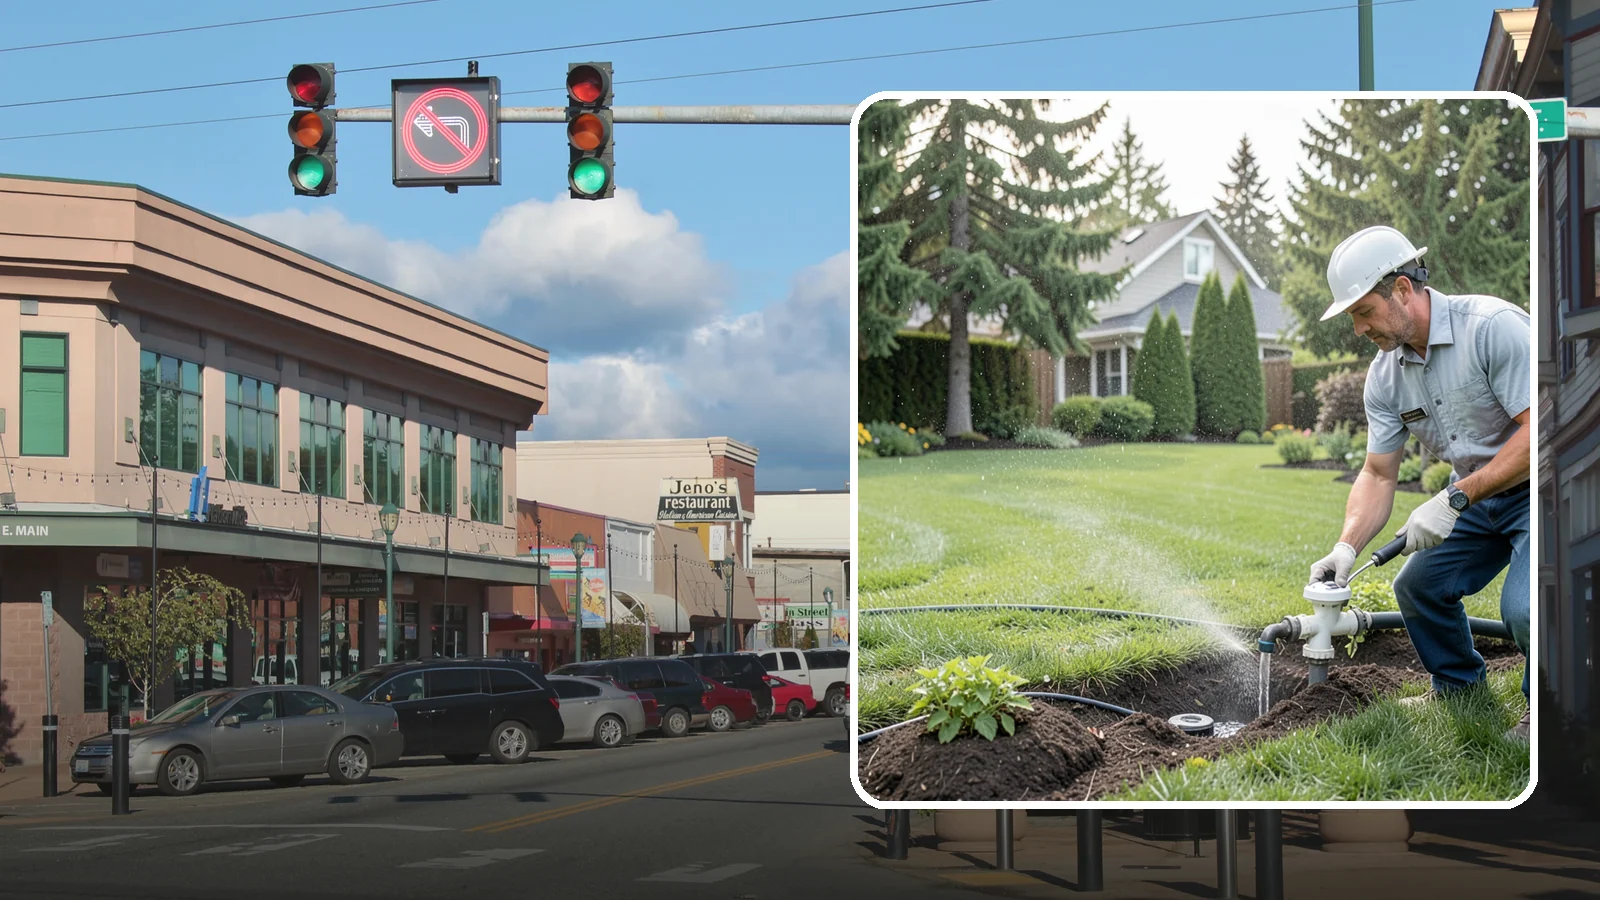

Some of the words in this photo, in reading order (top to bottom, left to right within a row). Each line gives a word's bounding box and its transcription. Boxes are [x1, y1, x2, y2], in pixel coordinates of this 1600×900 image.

[670, 480, 728, 495] Jeno's
[665, 497, 731, 509] restaurant
[658, 510, 682, 520] Italian
[686, 510, 714, 519] American
[715, 510, 737, 519] Cuisine
[2, 525, 13, 536] E.
[15, 525, 49, 536] MAIN
[797, 607, 829, 617] Street
[791, 619, 823, 627] lass
